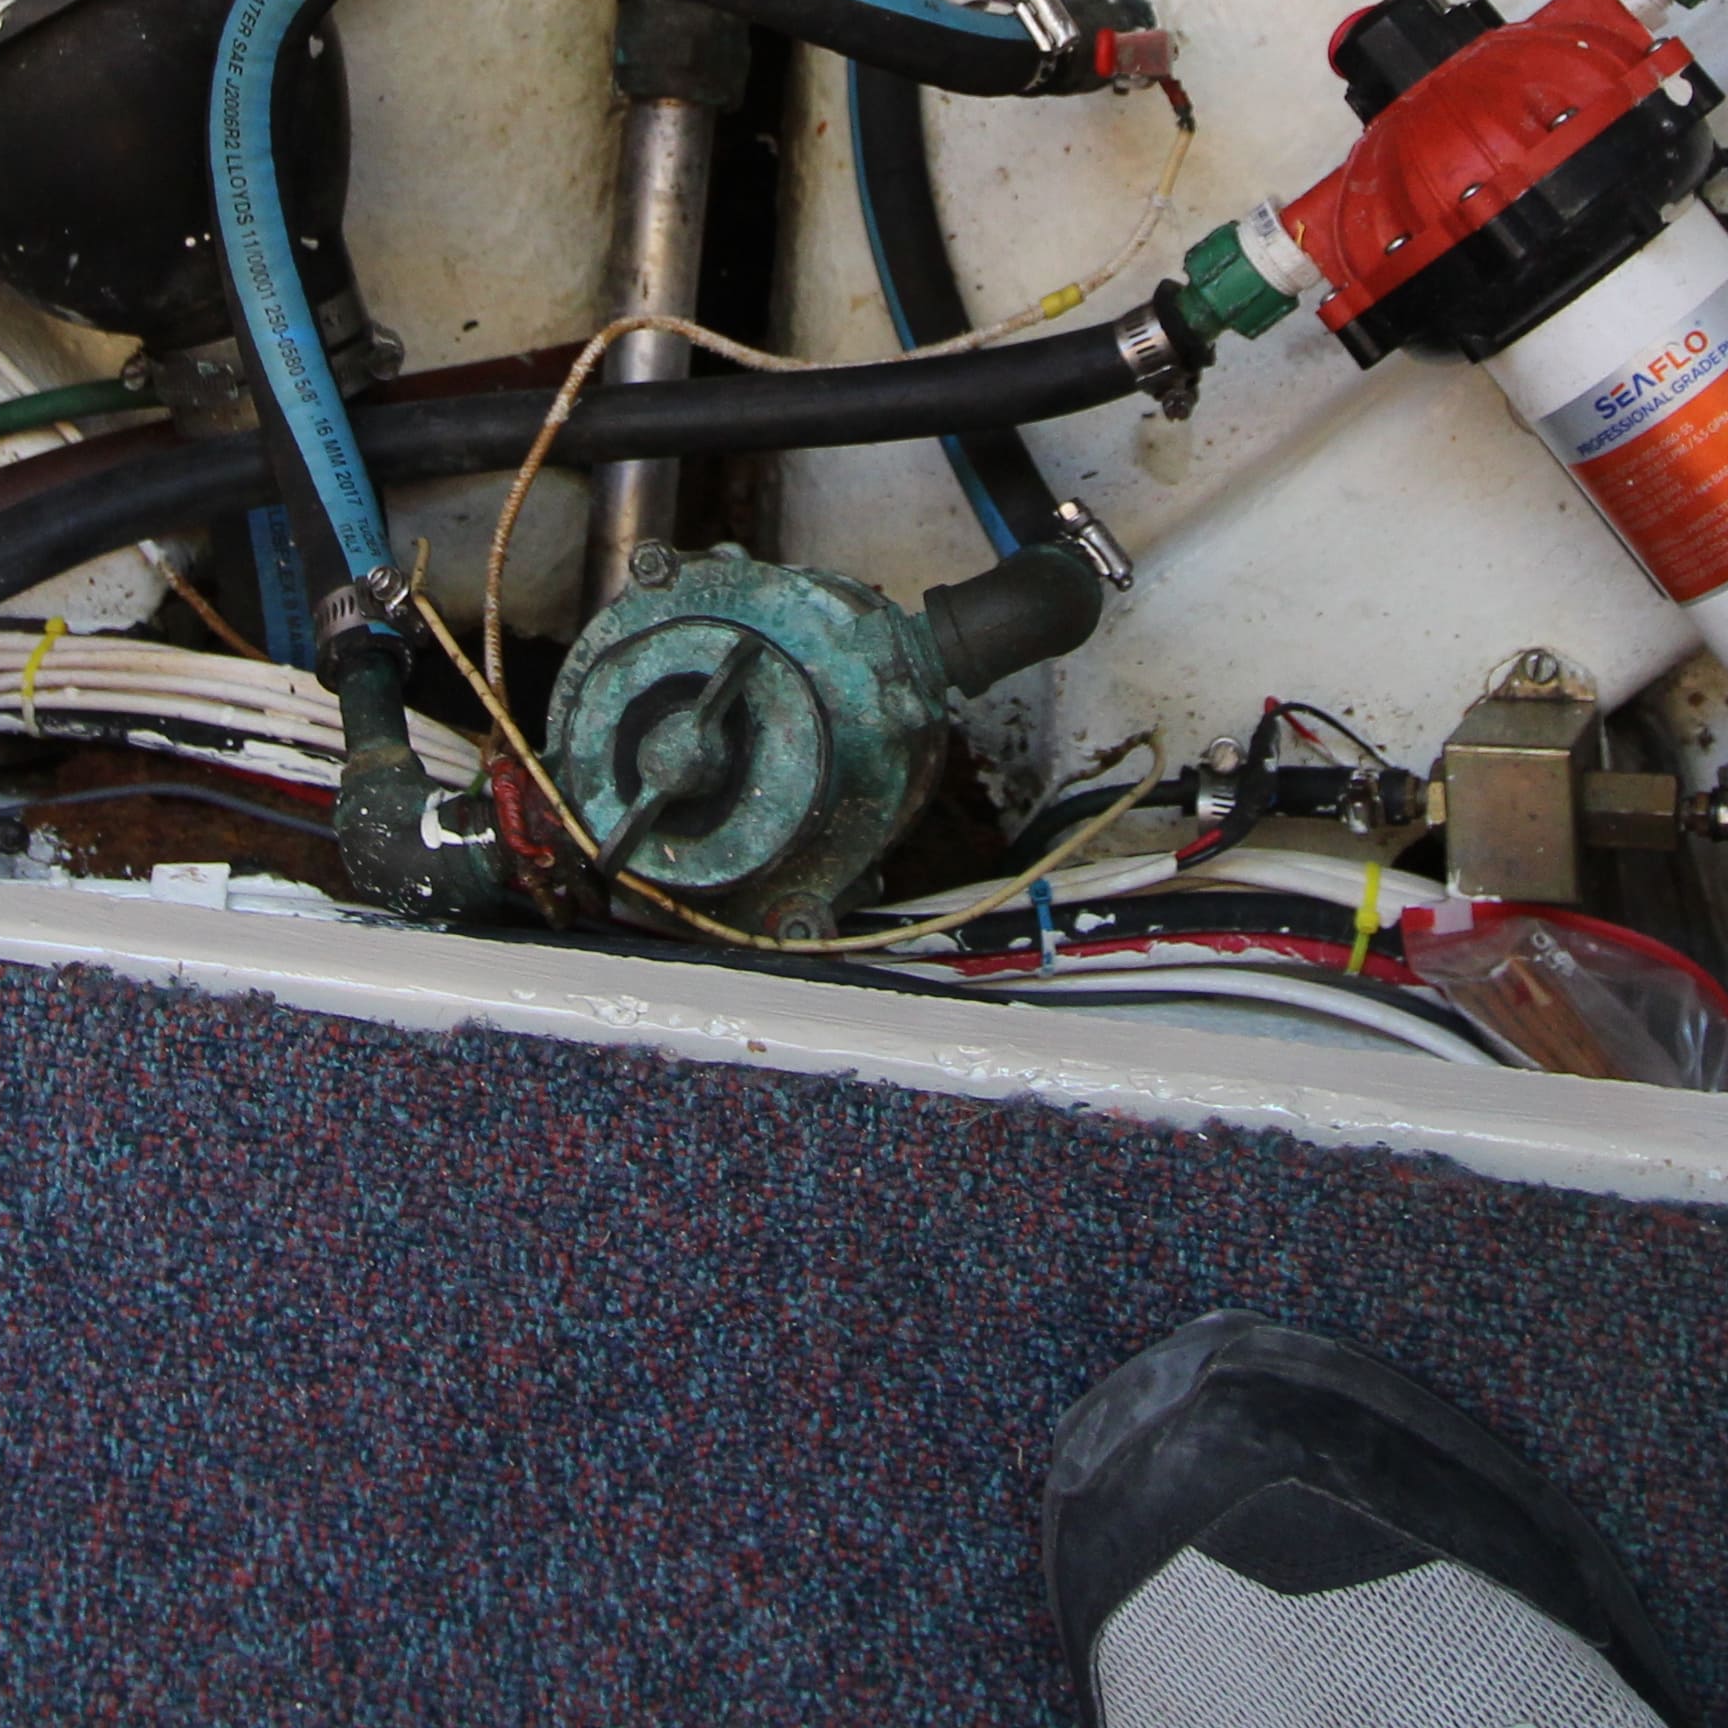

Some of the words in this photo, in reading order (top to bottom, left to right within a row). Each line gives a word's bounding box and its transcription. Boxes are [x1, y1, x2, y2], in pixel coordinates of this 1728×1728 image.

[227, 37, 248, 76] SAE
[223, 76, 241, 150] J2006R2
[226, 153, 254, 226] LLOYDS
[264, 304, 306, 378] 250-0580
[1594, 330, 1709, 420] SEAFLO
[1576, 391, 1672, 457] PROFESSIONAL
[1672, 351, 1721, 395] GRADE
[324, 438, 347, 469] MM
[335, 470, 364, 507] 2017
